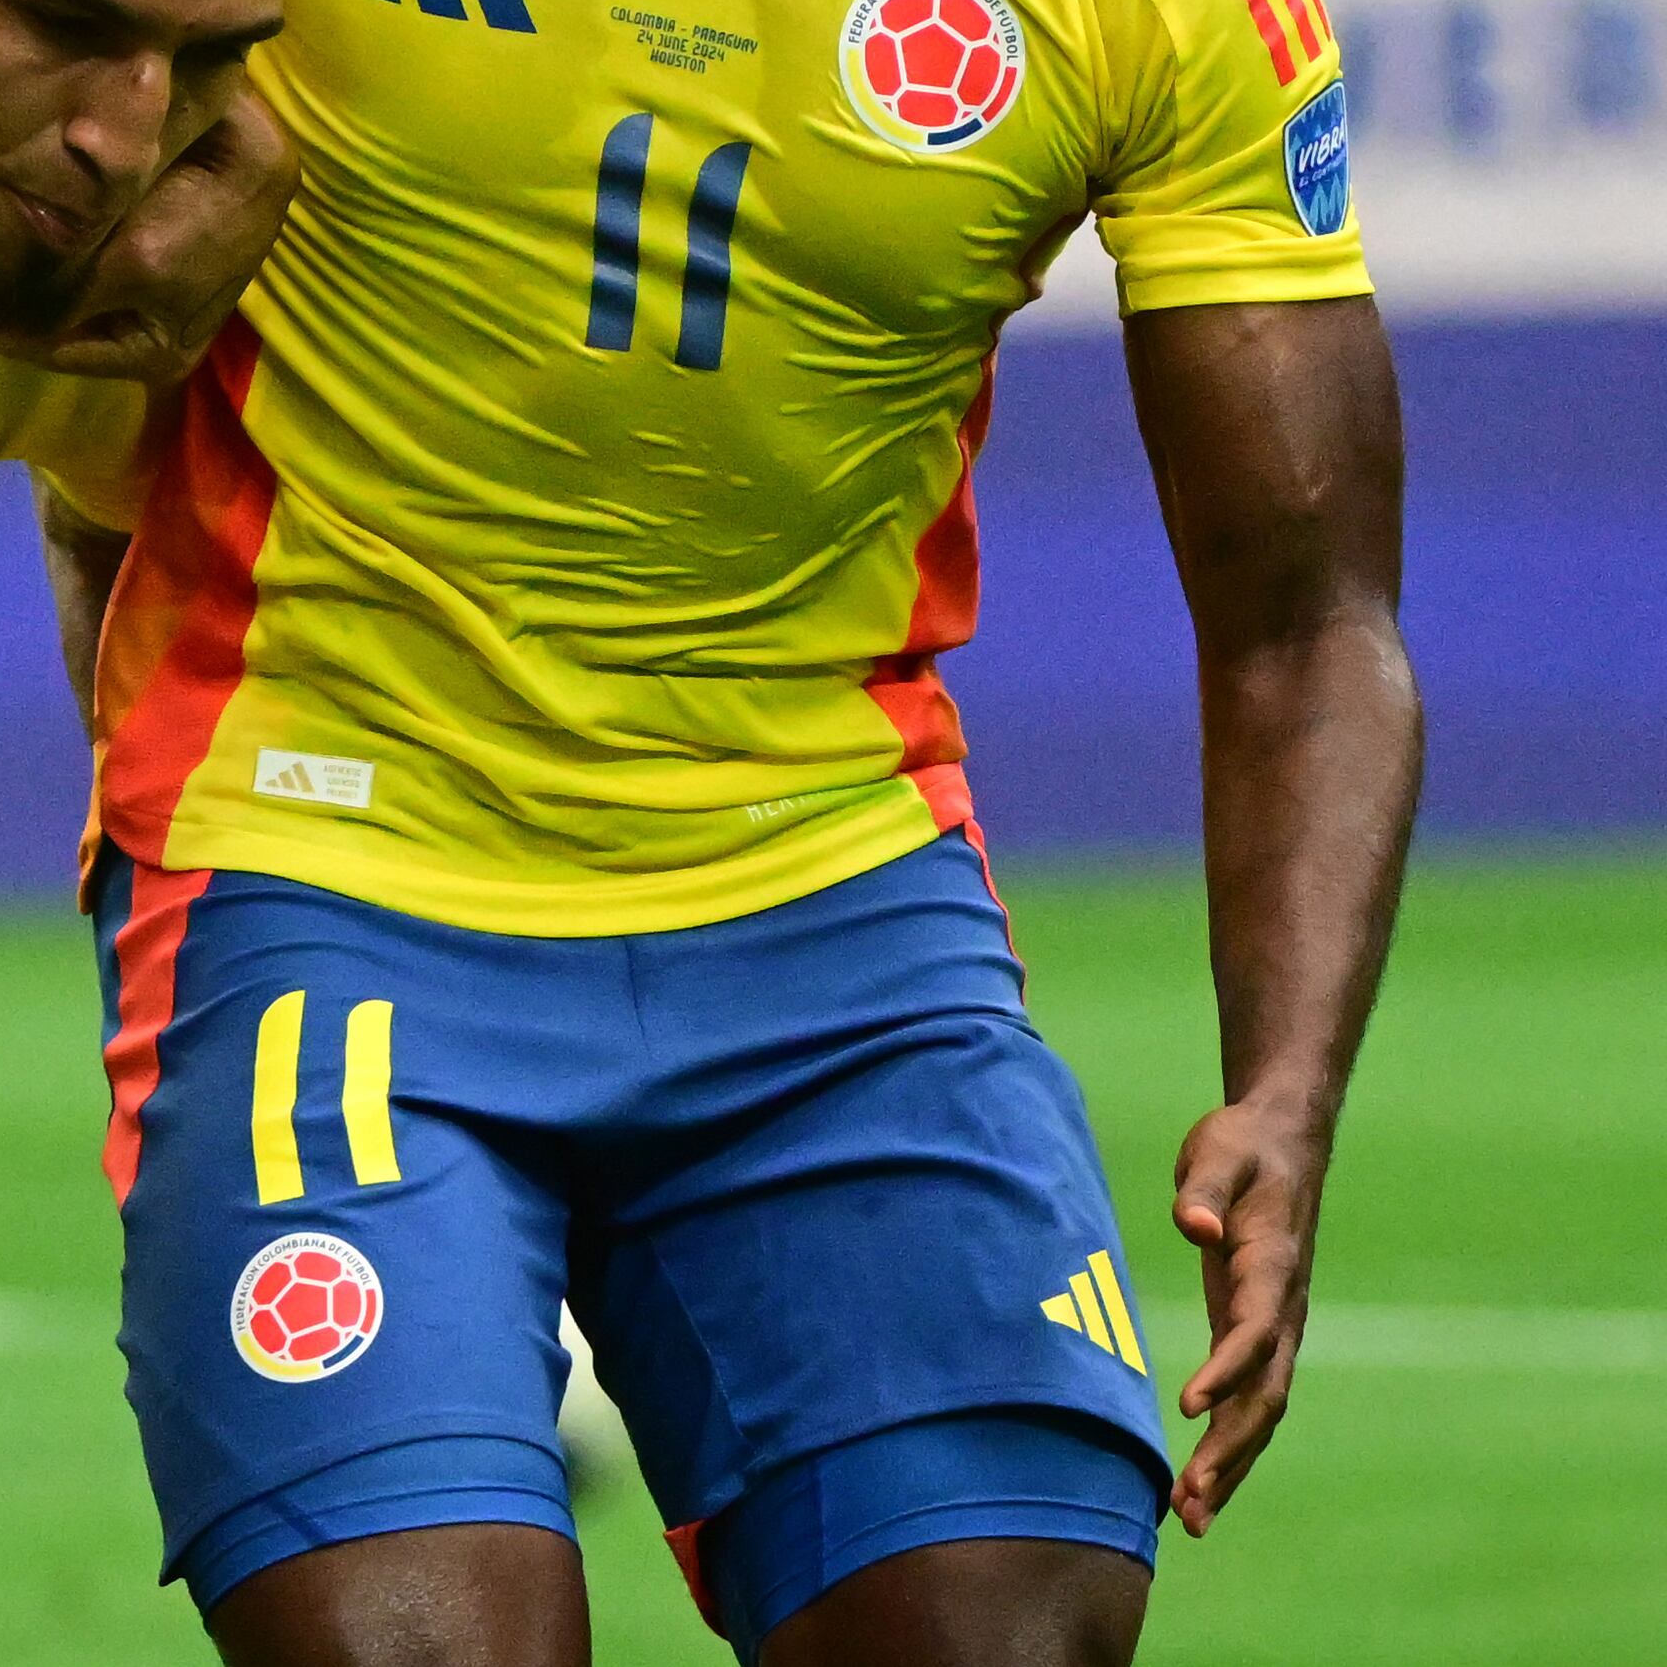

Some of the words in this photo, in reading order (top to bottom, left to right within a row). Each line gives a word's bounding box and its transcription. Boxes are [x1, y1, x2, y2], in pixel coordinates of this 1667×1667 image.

[610, 6, 677, 34] COLOMBIA
[692, 24, 759, 55] PARAGUAY
[636, 29, 654, 45] 24
[657, 33, 689, 53] JUNE
[692, 41, 726, 62] 2024
[650, 48, 707, 74] HOUSTON
[585, 112, 752, 370] 11
[250, 989, 403, 1205] 11
[257, 1238, 327, 1270] COLOMBIANA
[328, 1242, 342, 1254] DE
